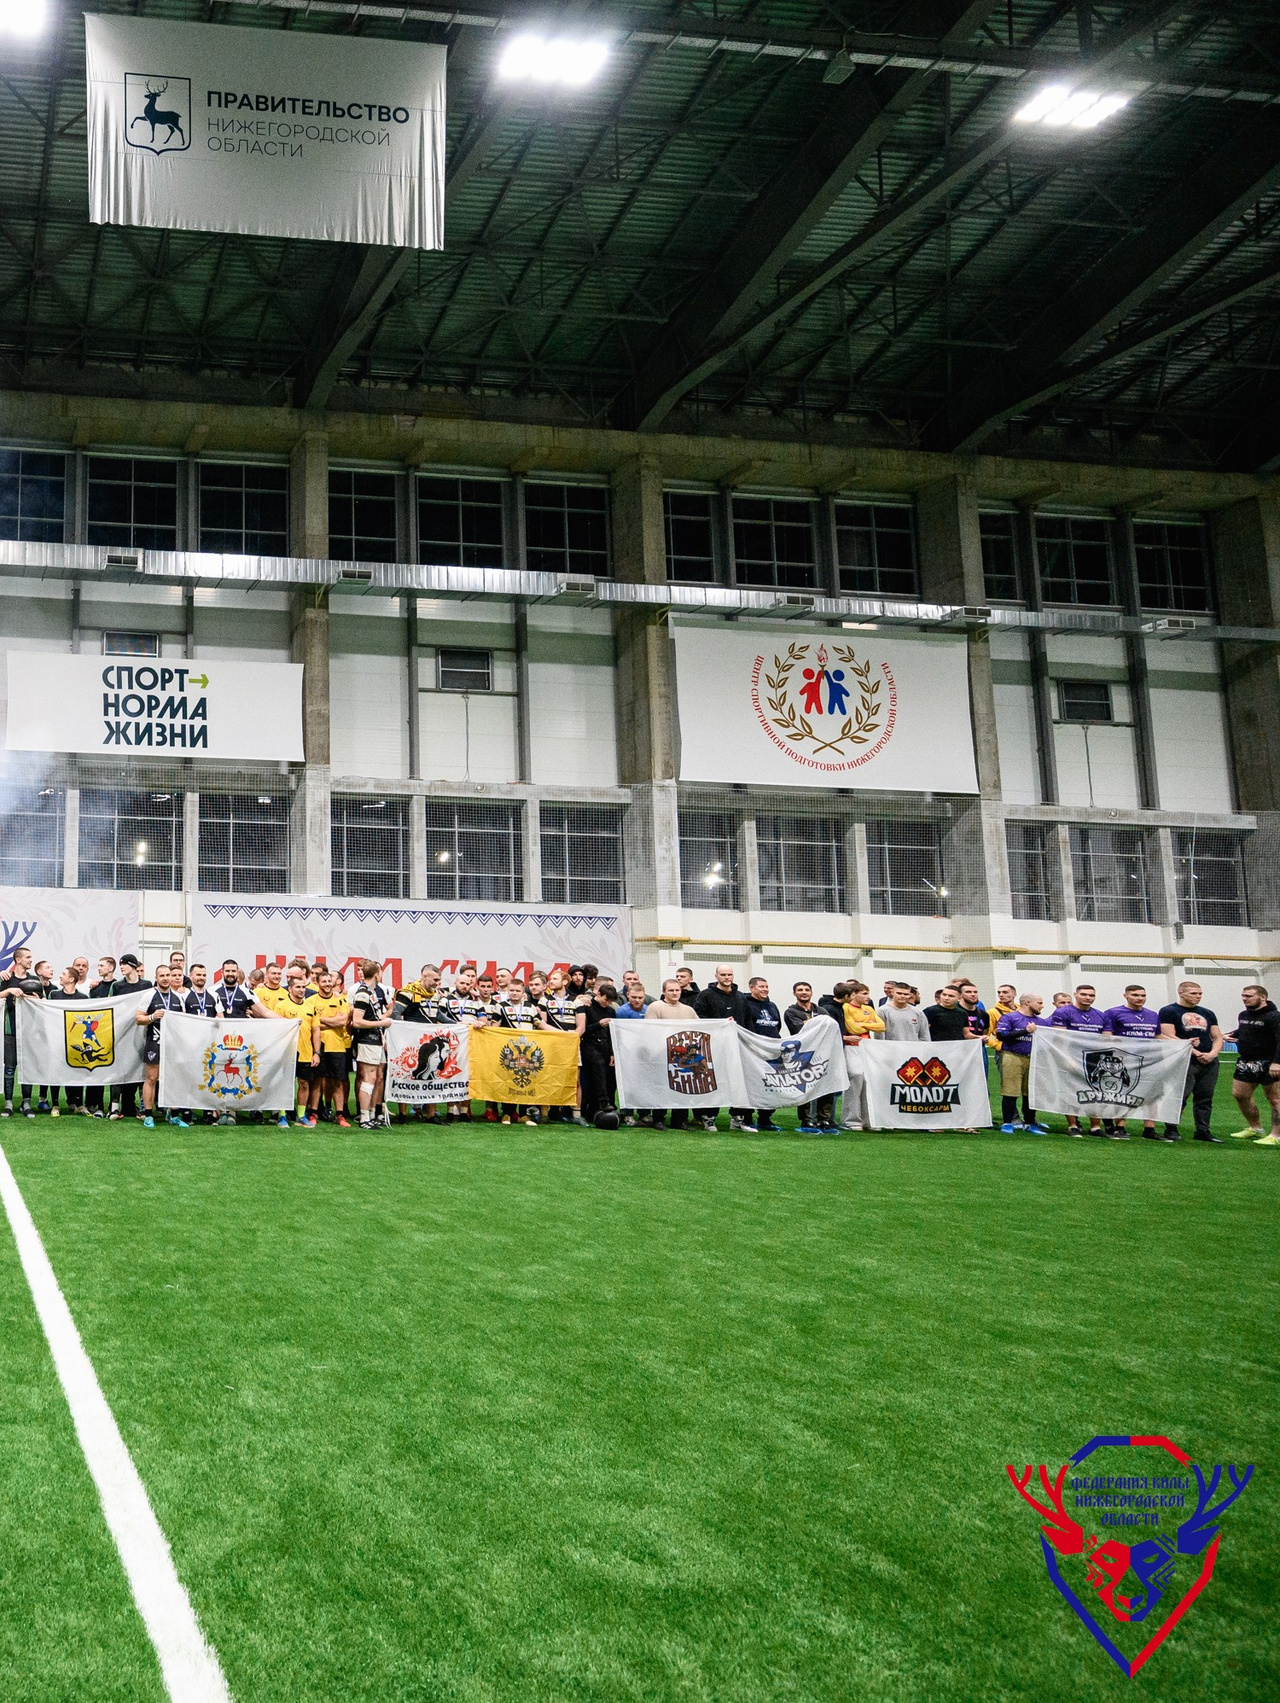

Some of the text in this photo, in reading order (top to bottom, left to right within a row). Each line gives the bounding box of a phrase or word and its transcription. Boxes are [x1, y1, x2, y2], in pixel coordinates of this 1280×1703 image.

[207, 91, 410, 124] ПРАВИТЕЛЬСТВО
[207, 118, 390, 146] НИЖЕГОРОДСКОЙ
[207, 137, 303, 158] ОБЛАСТИ
[102, 665, 190, 692] СПОРТ
[103, 693, 208, 721] НОРМА
[751, 655, 898, 772] ЦЕНТР СПОРТИВНОЙ ПОДГОТОВКИ НИЖЕГОРОДСКОЙ ОБЛАСТИ
[102, 720, 208, 748] ЖИЗНИ
[894, 1086, 958, 1103] МОЛОТ
